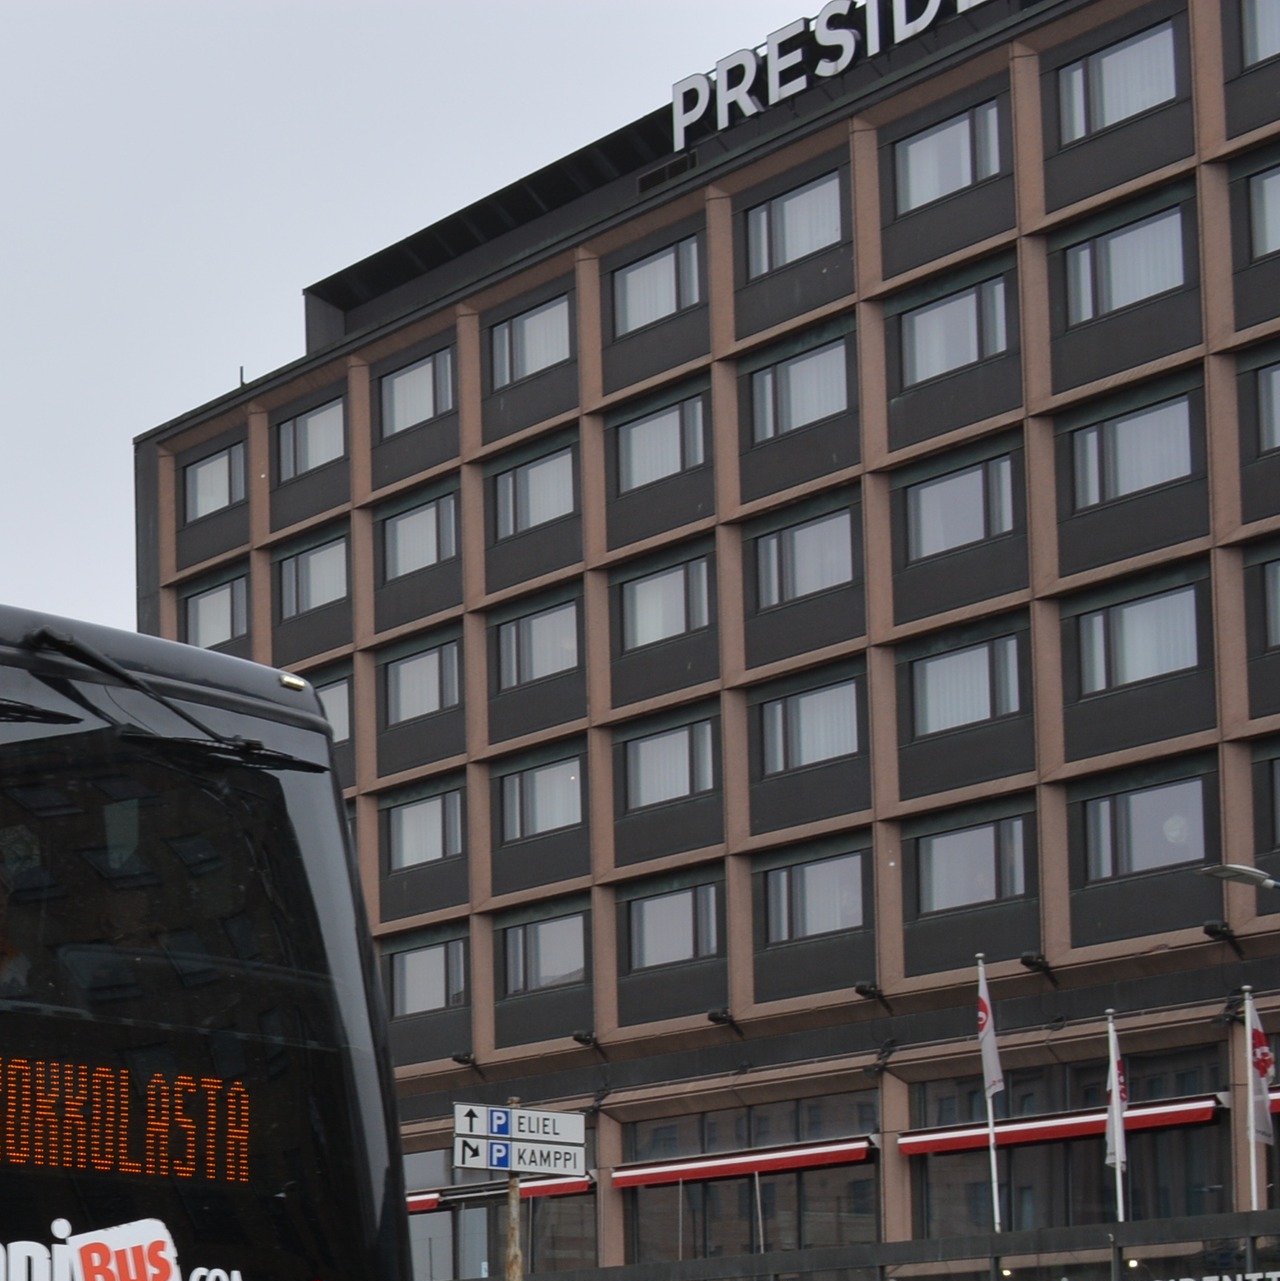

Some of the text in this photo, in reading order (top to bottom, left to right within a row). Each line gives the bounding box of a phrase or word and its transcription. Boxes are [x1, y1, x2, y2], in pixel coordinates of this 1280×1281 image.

[672, 0, 989, 153] PRESID
[492, 1111, 560, 1135] P ELIEL
[492, 1144, 577, 1169] P KAMPPI
